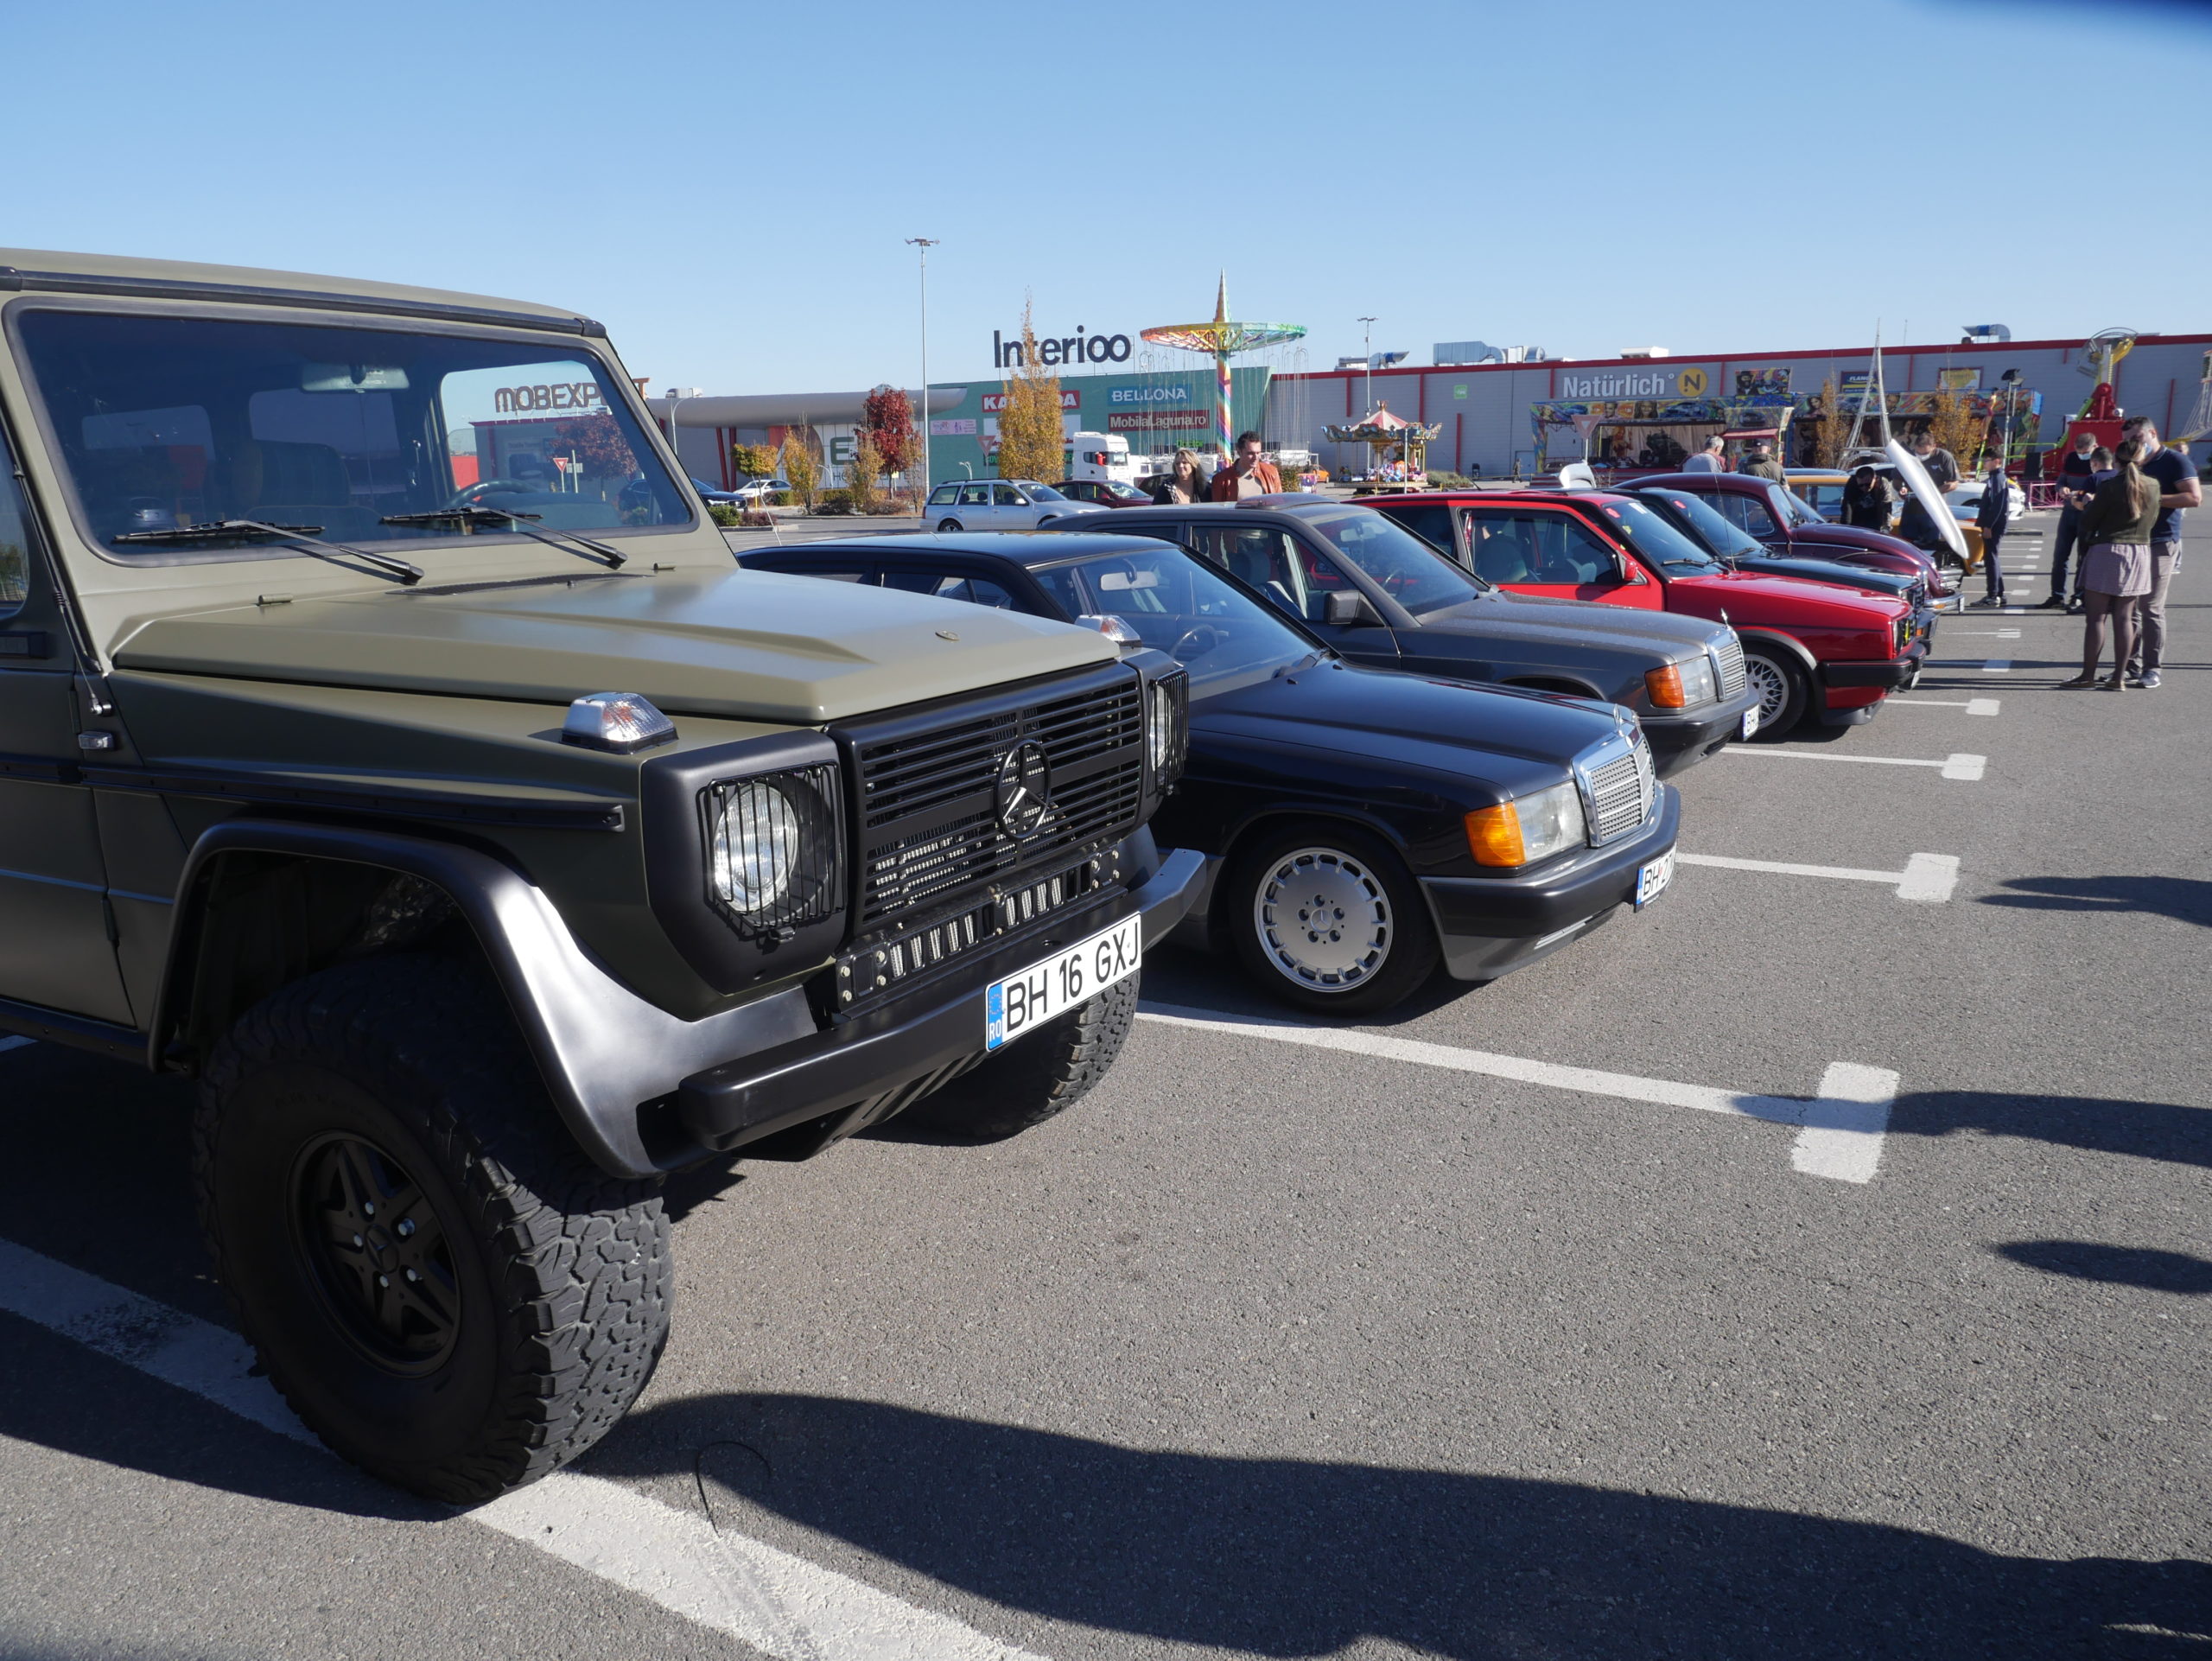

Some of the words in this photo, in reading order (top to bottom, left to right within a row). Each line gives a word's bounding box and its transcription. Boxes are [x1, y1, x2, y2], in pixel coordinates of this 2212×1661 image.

[1111, 388, 1187, 402] BELLONA
[1109, 416, 1206, 429] MobilaLaguna.ro
[1643, 862, 1660, 896] BH
[1007, 969, 1048, 1033] BH
[1059, 953, 1083, 1003] 16
[1096, 922, 1139, 983] GXJ
[988, 1019, 1002, 1042] RO
